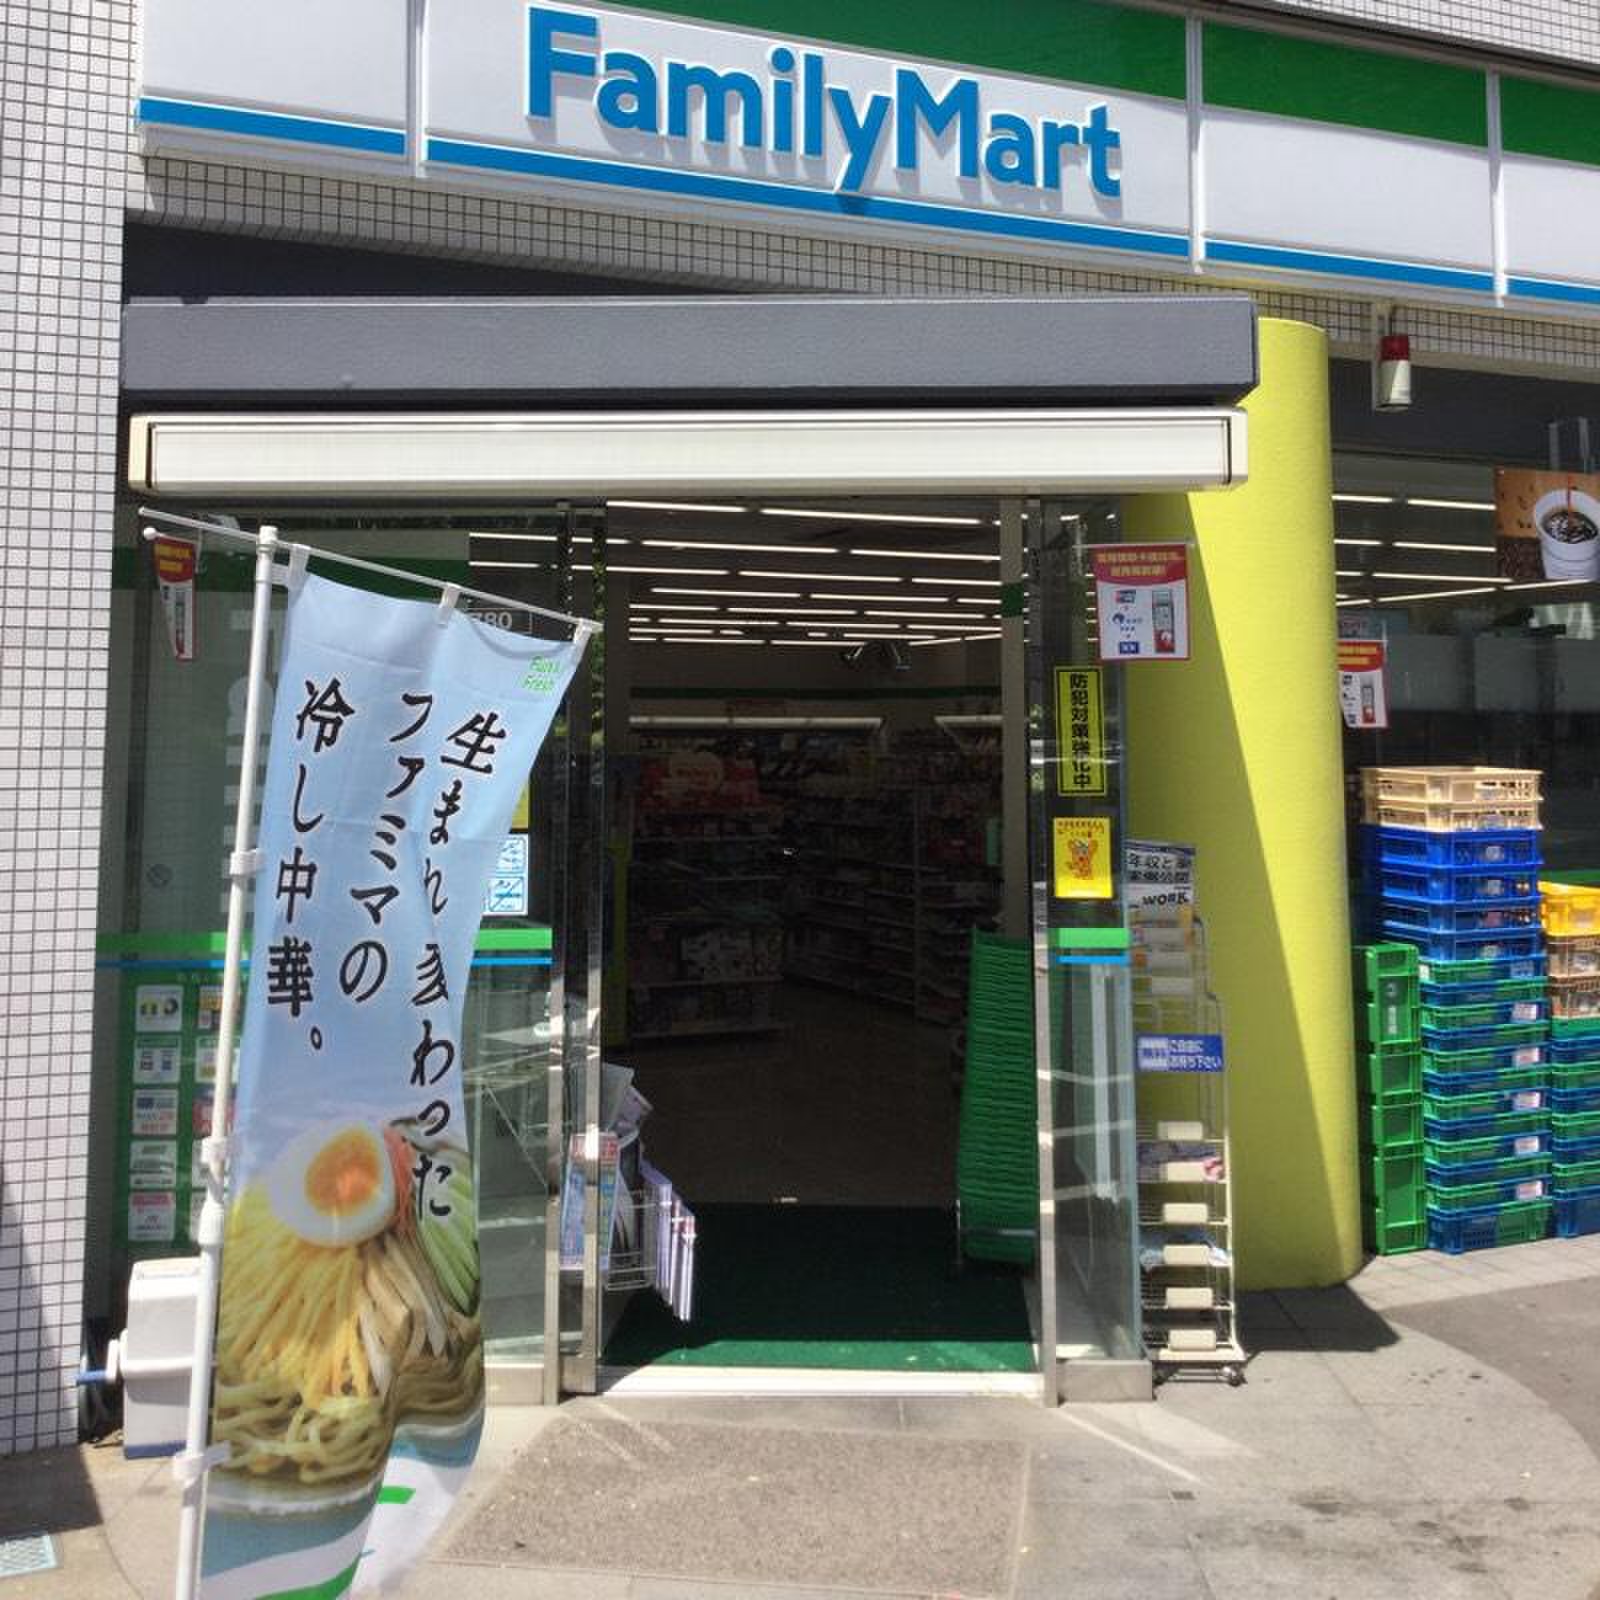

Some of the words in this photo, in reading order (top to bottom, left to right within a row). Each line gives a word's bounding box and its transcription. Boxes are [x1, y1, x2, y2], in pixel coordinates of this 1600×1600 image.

[525, 6, 1122, 198] FamilyMart
[267, 677, 355, 1050] 冷し中華。
[339, 692, 433, 1003] ファミマの
